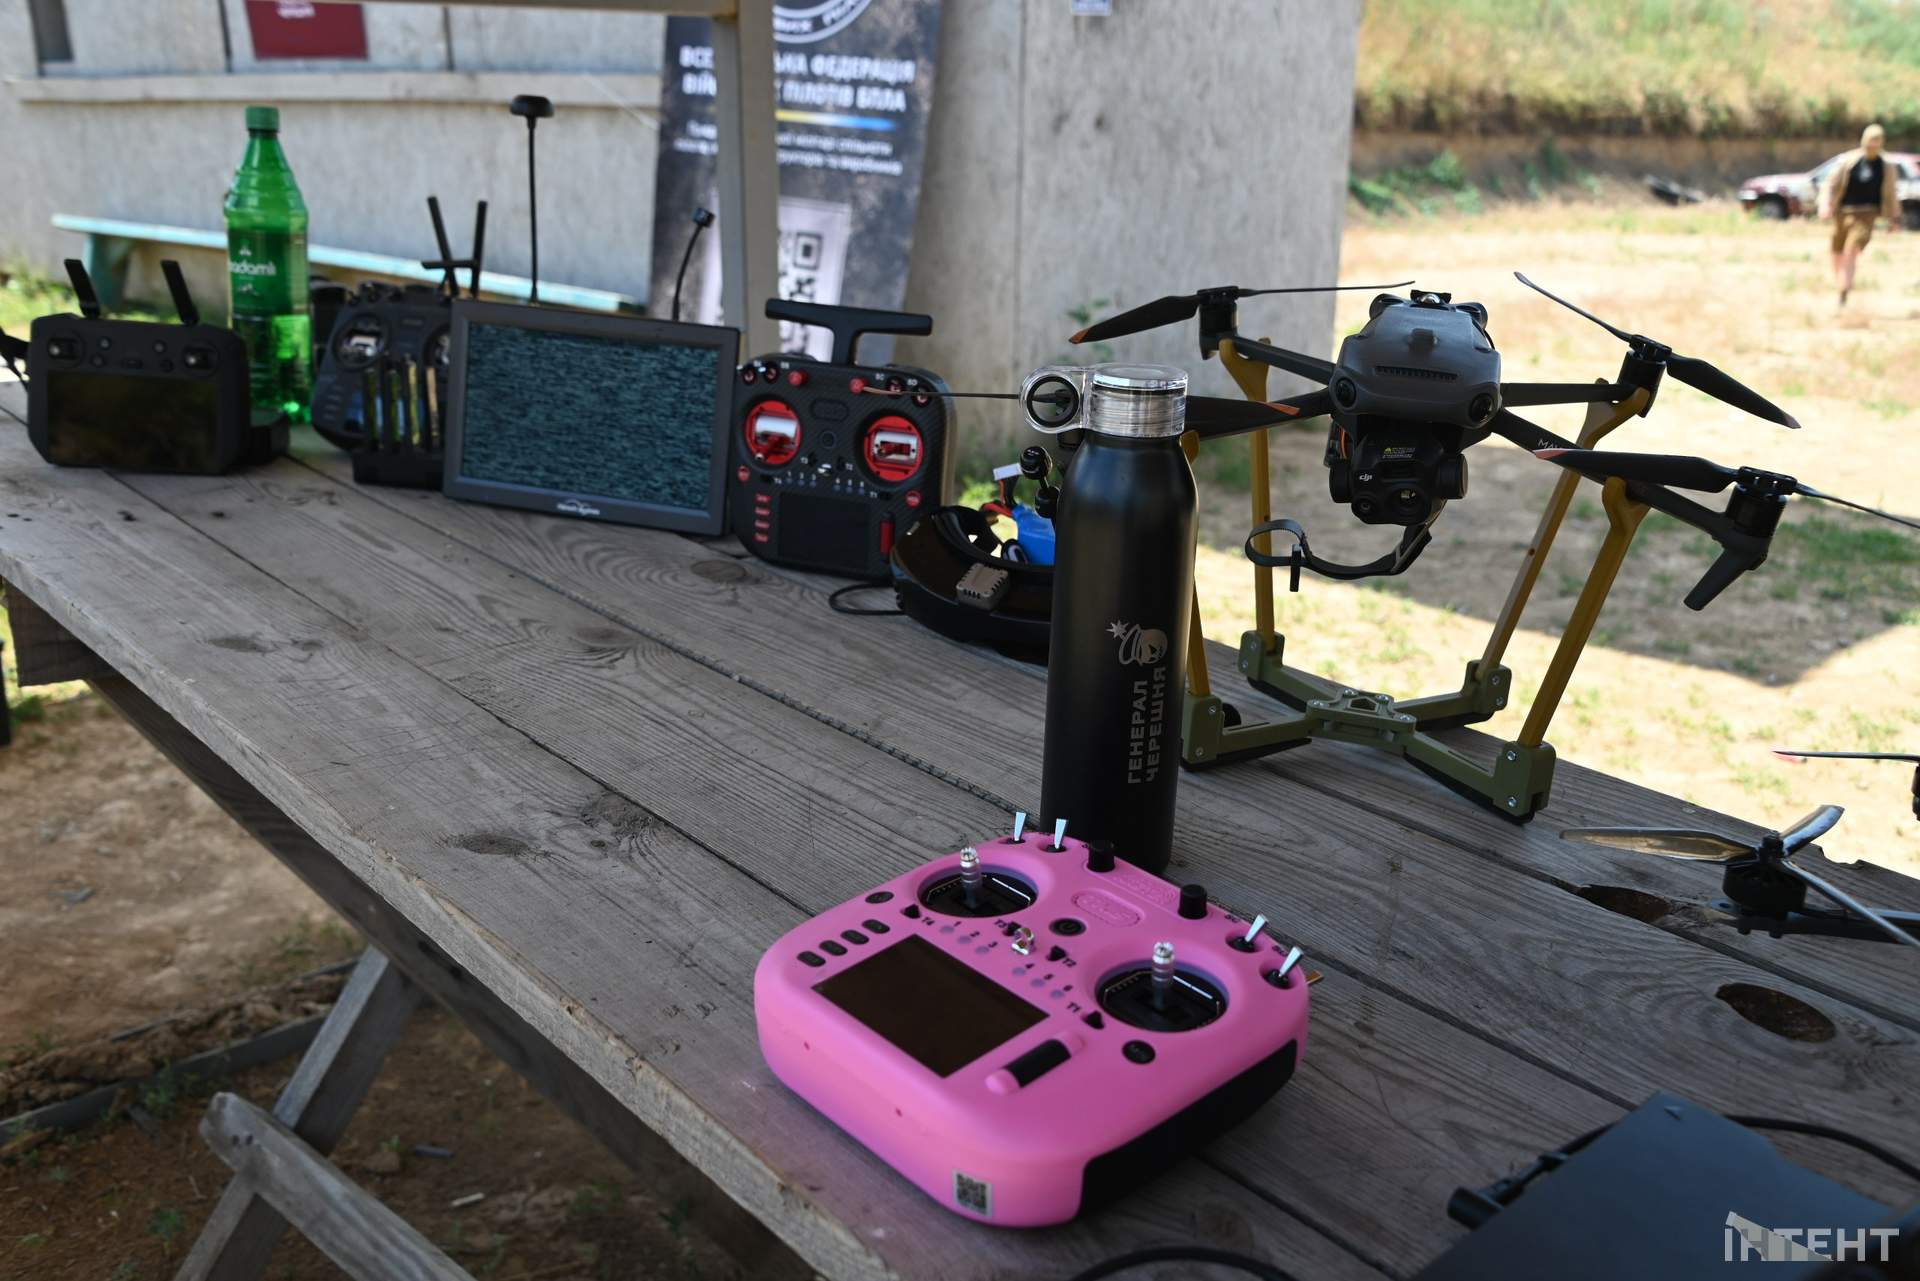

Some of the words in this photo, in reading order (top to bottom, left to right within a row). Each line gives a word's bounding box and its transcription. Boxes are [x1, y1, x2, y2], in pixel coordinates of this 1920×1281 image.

[810, 54, 916, 85] ФЕДЕРАЦІЯ
[855, 85, 907, 112] БПЛА
[1127, 680, 1148, 784] ГЕНЕРАЛ
[1146, 667, 1167, 783] ЧЕРЕШНЯ
